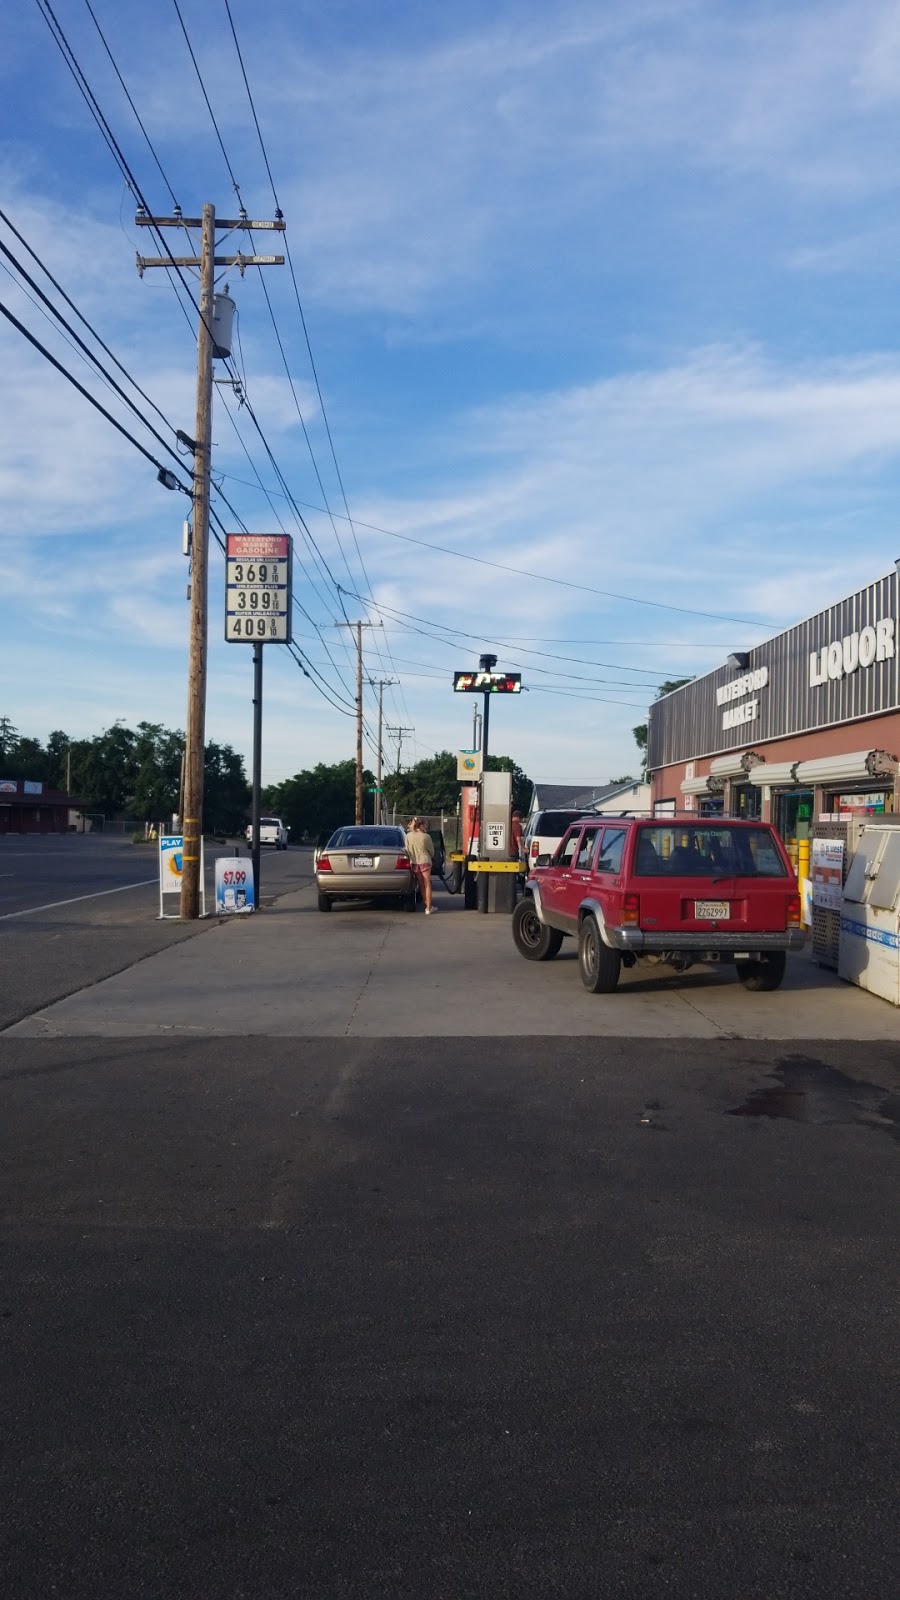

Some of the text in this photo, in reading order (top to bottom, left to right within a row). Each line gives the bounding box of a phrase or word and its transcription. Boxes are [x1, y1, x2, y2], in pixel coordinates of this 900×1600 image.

[235, 564, 267, 582] 369
[238, 591, 270, 609] 399
[233, 618, 266, 636] 409
[810, 617, 895, 688] LIQUOR
[716, 666, 769, 707] WATERFORD
[722, 698, 760, 731] MARKET
[492, 836, 499, 847] 5
[223, 871, 247, 885] $7.99
